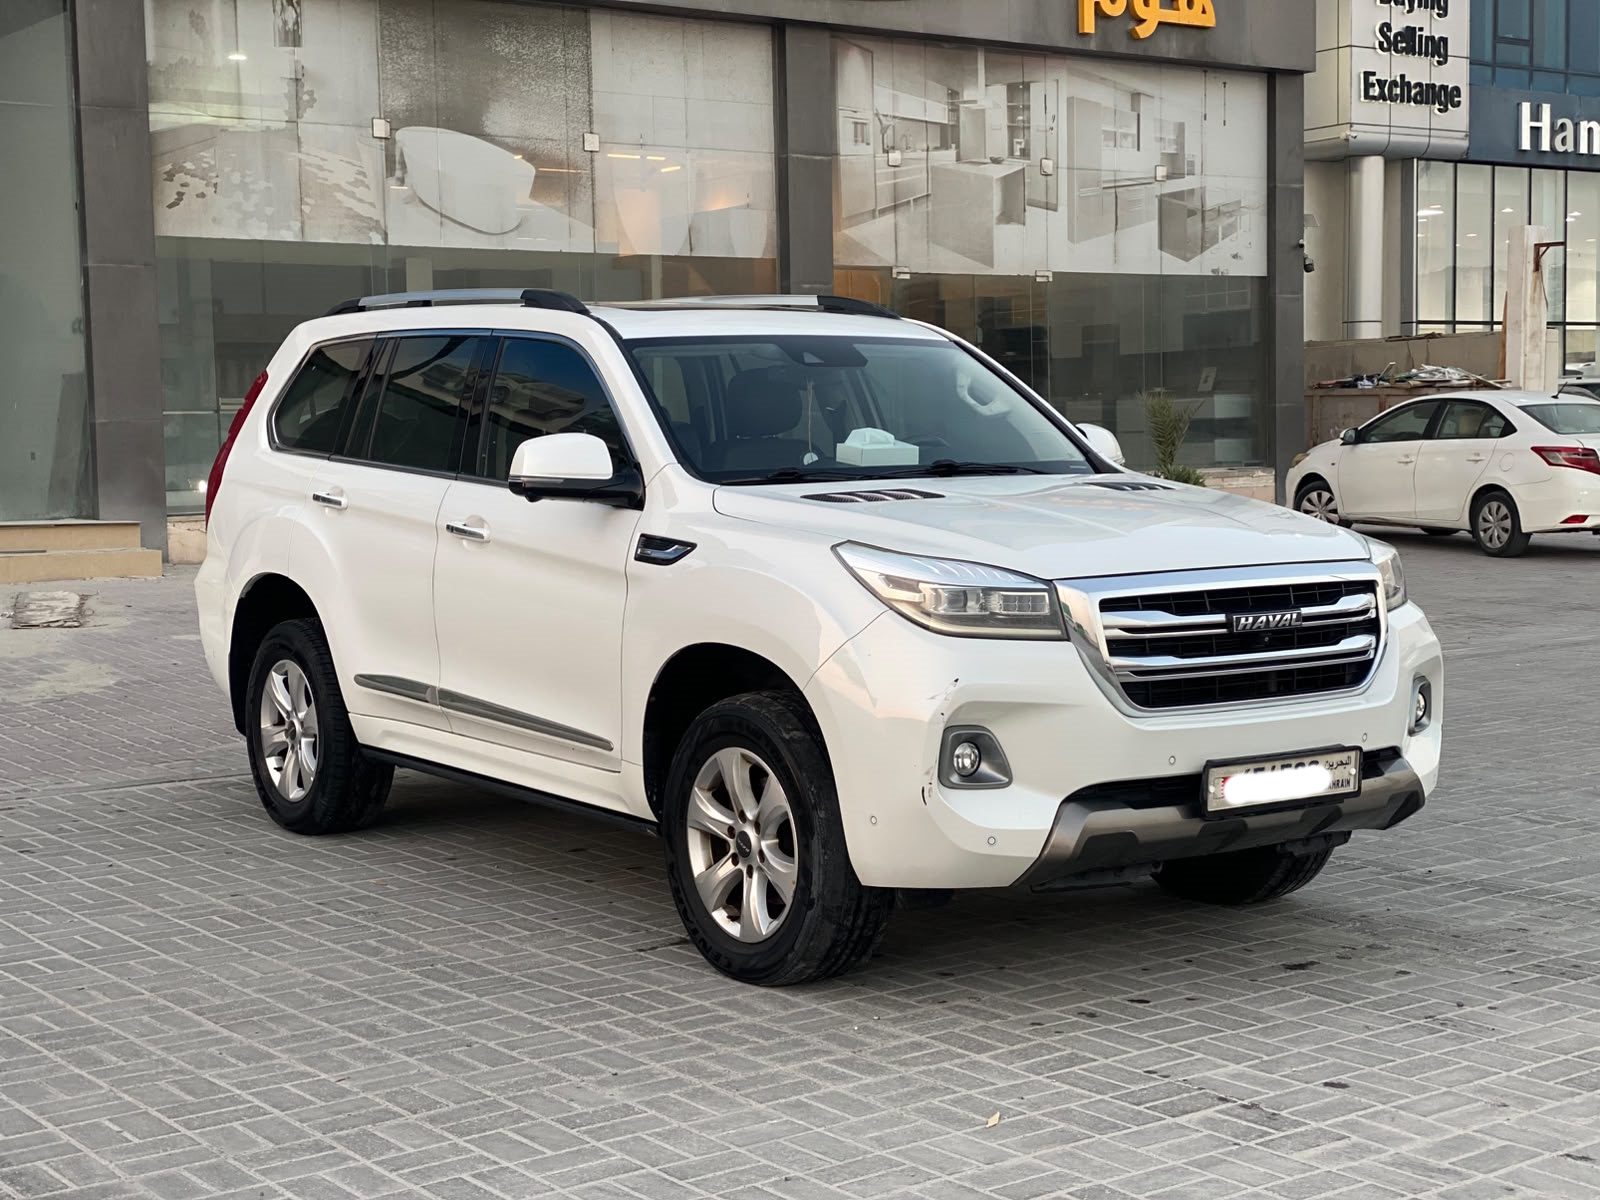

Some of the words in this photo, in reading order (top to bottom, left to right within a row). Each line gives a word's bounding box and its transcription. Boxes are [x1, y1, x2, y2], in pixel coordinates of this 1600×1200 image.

[1377, 22, 1449, 66] Selling
[1361, 71, 1462, 114] Exchange
[1237, 613, 1301, 631] HAVAL
[1325, 755, 1352, 771] البحرين
[1328, 777, 1351, 790] AHRAIN
